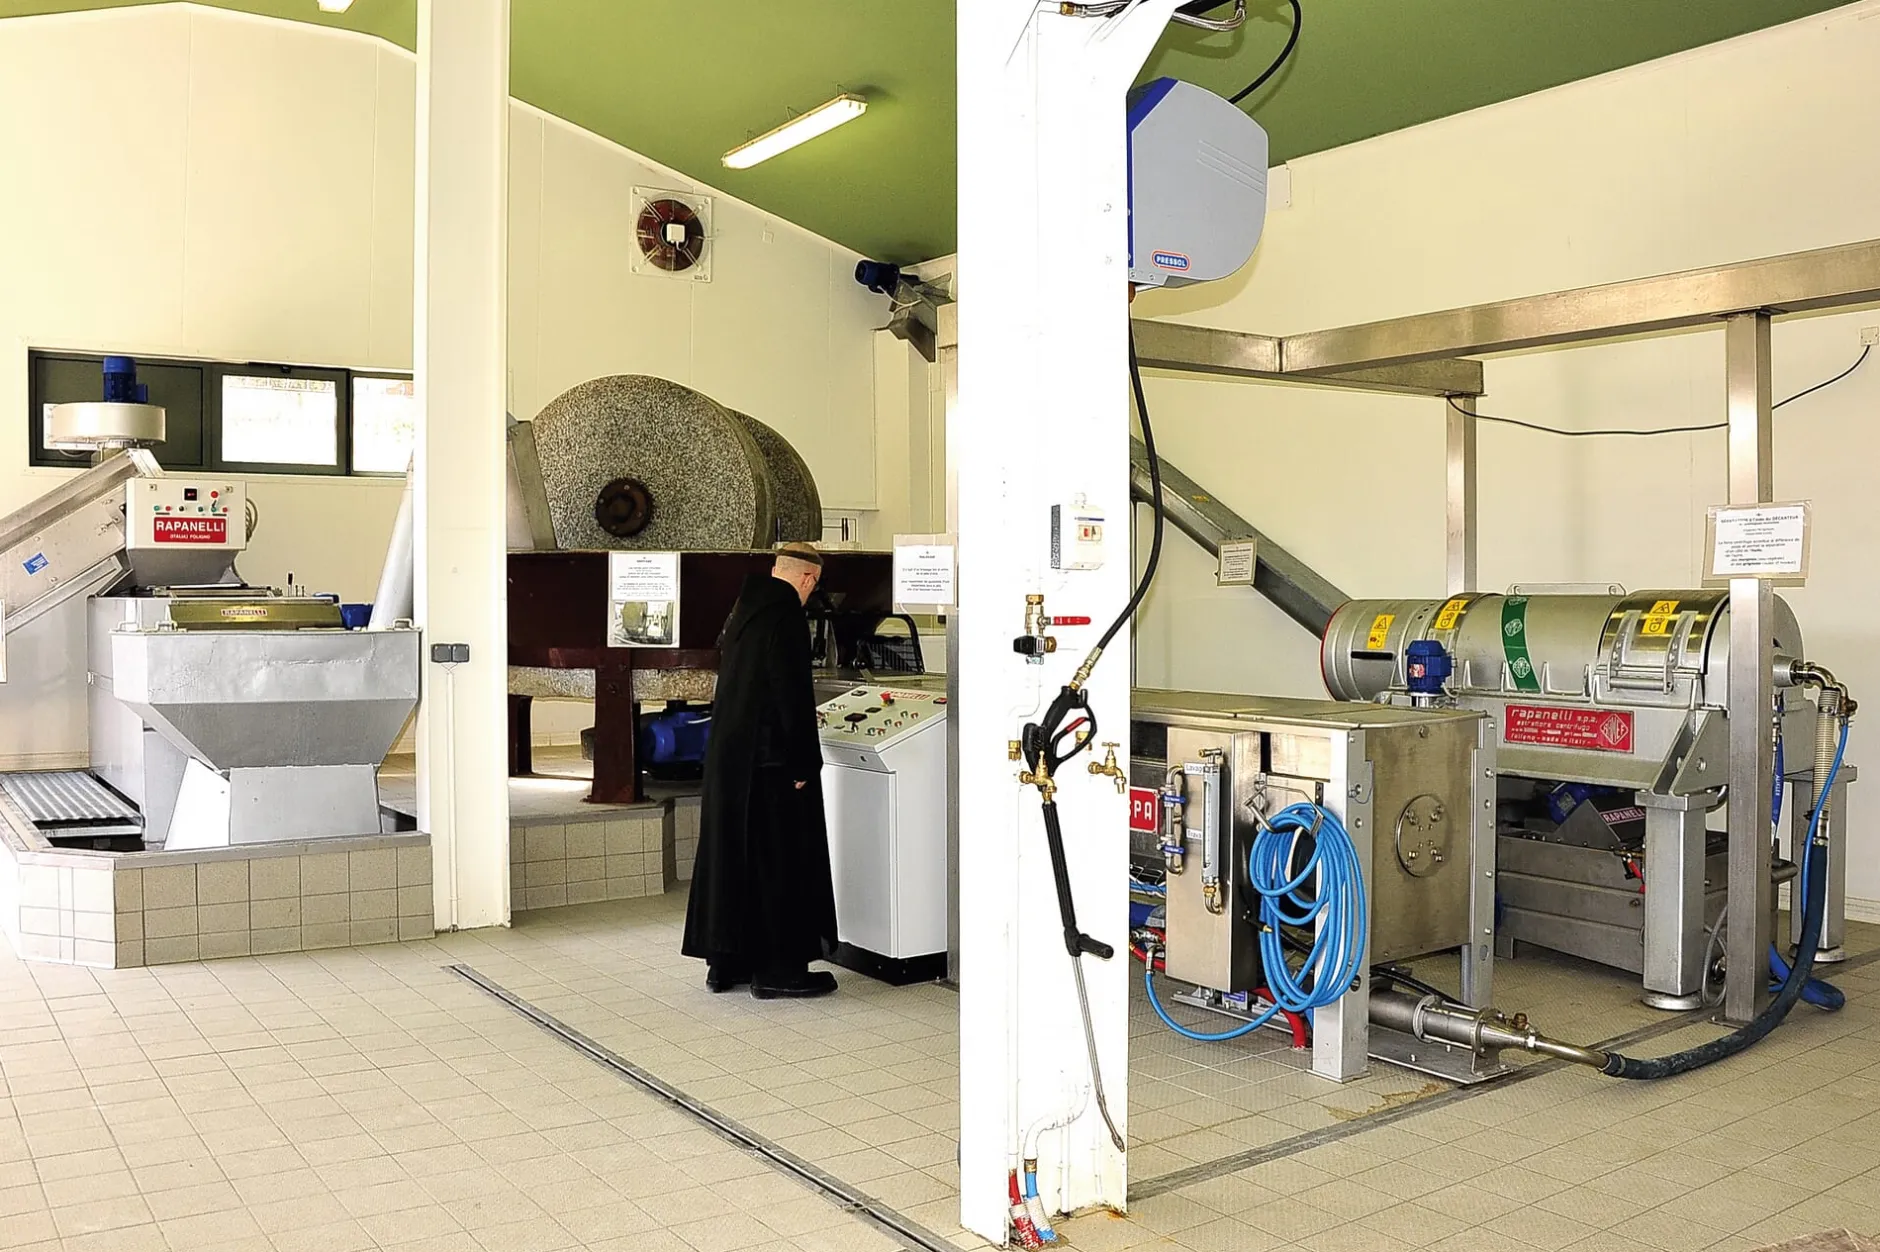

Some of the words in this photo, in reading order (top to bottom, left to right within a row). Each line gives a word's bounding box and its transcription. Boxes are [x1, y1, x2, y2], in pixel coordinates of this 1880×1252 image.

[1156, 256, 1186, 266] PRESSOL
[156, 521, 224, 532] RAPANELLI
[1511, 709, 1573, 721] rapanelli
[1128, 799, 1153, 821] PA
[1602, 808, 1646, 823] RAPANELL
